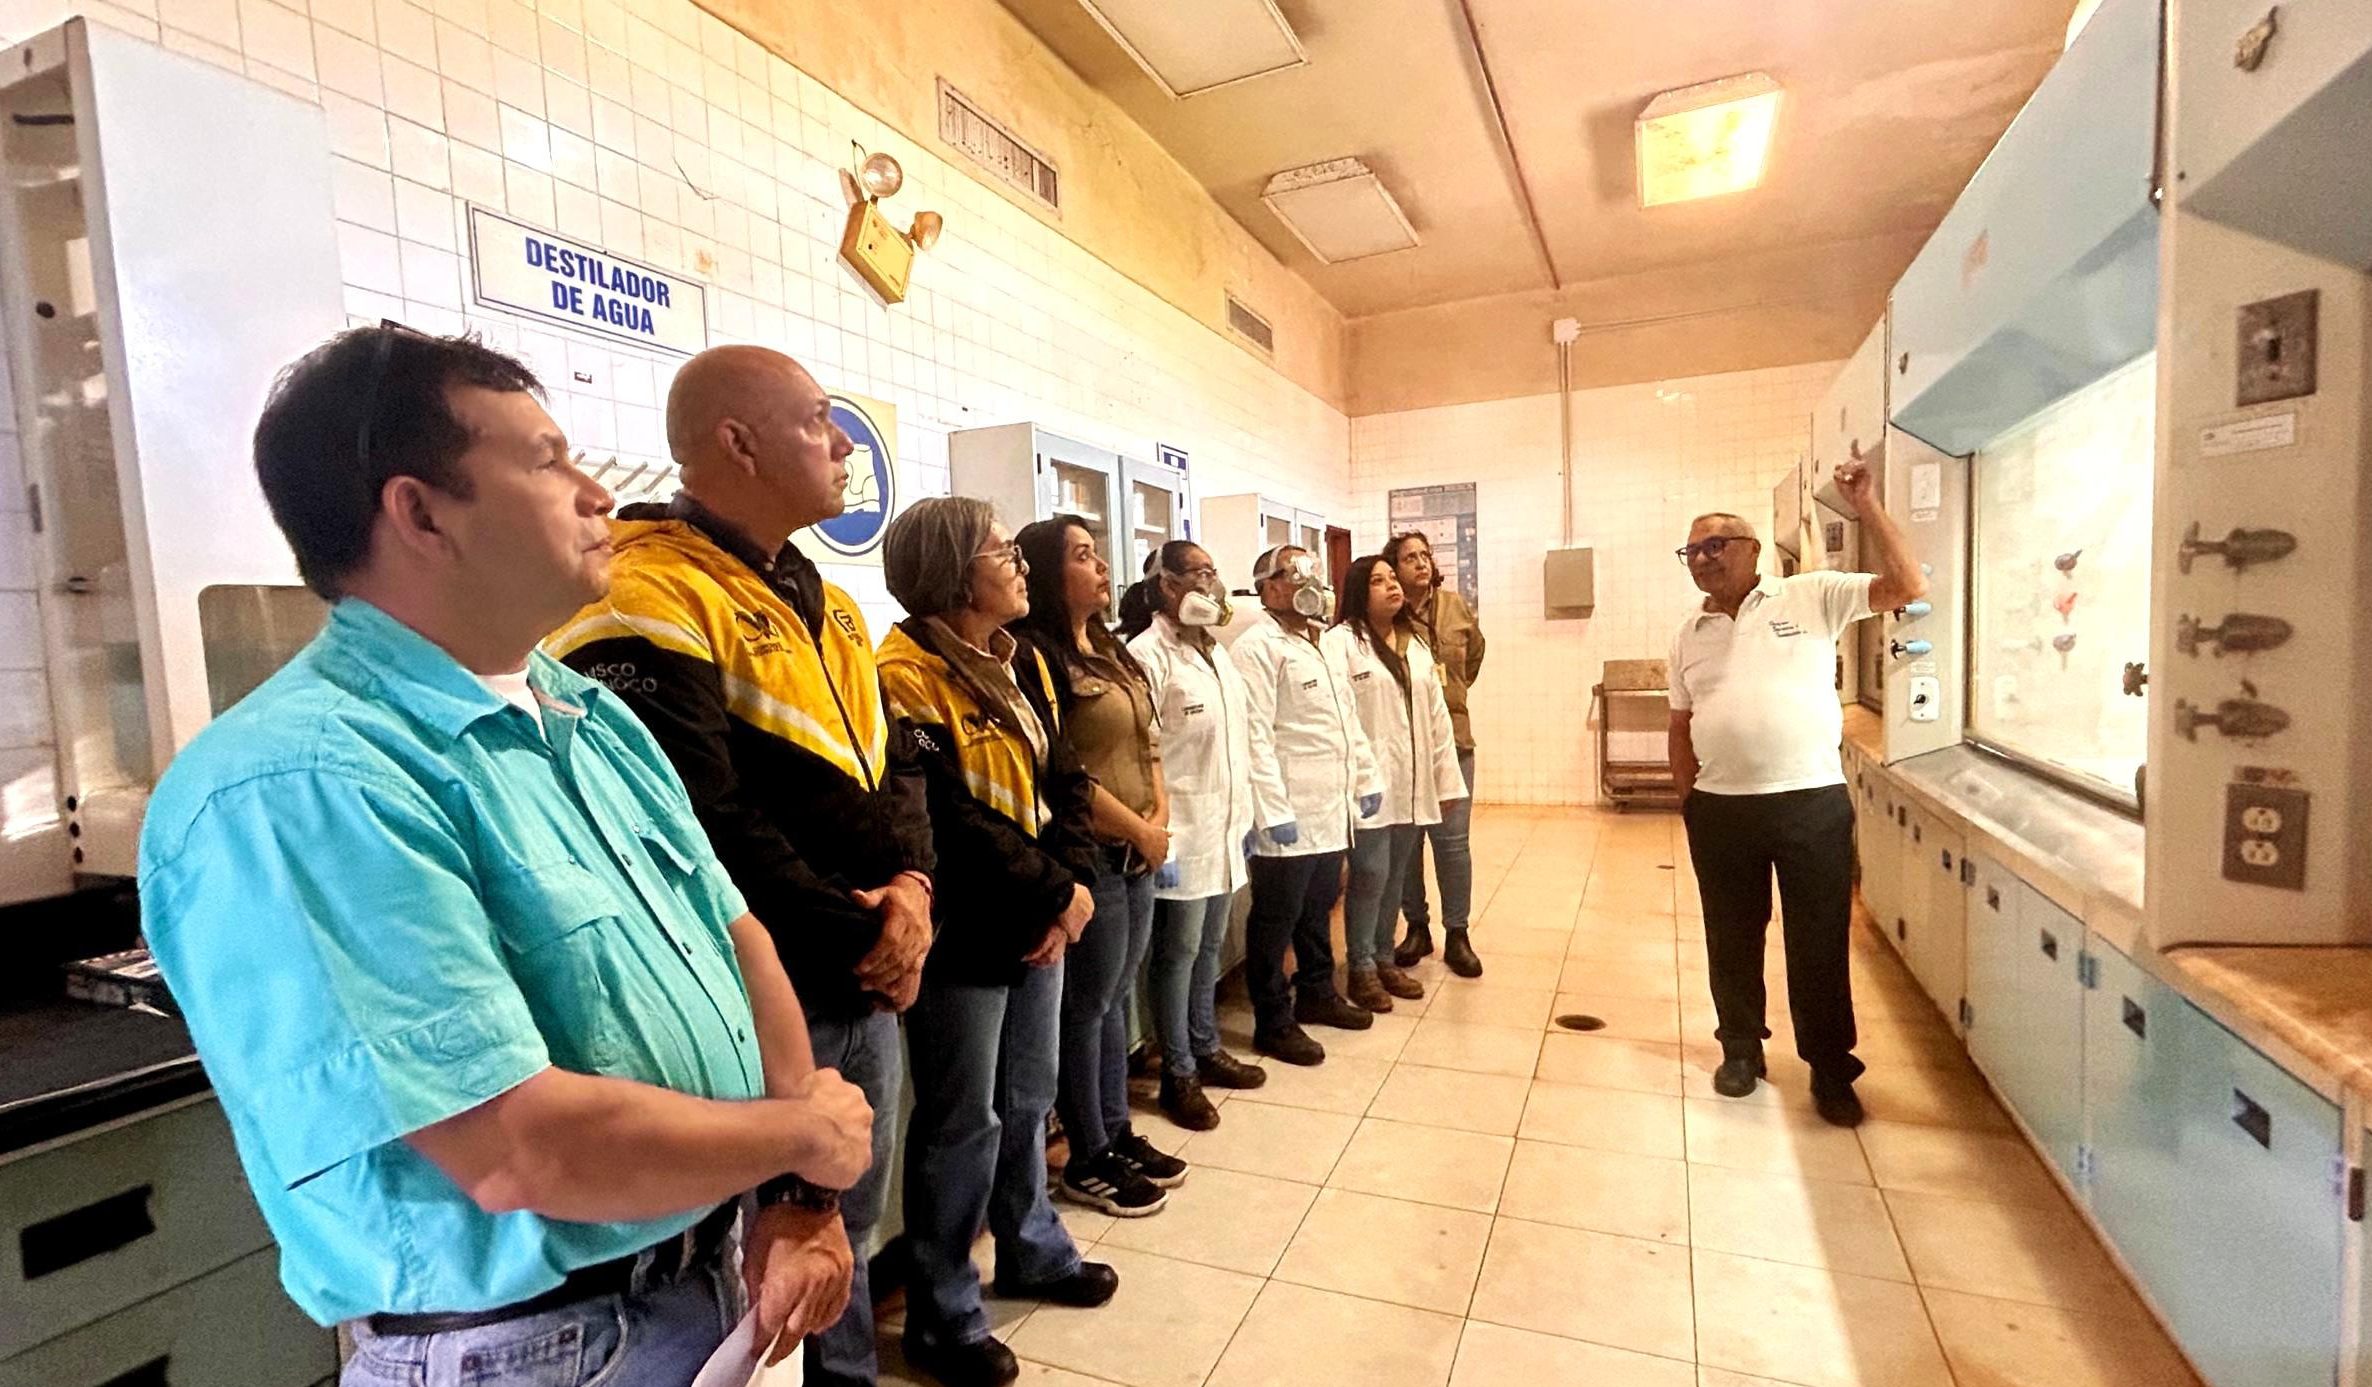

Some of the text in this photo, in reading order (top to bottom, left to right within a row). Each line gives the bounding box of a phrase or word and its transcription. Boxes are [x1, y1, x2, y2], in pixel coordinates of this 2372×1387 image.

[524, 236, 671, 308] DESTILADOR
[551, 280, 655, 336] DE AGUA
